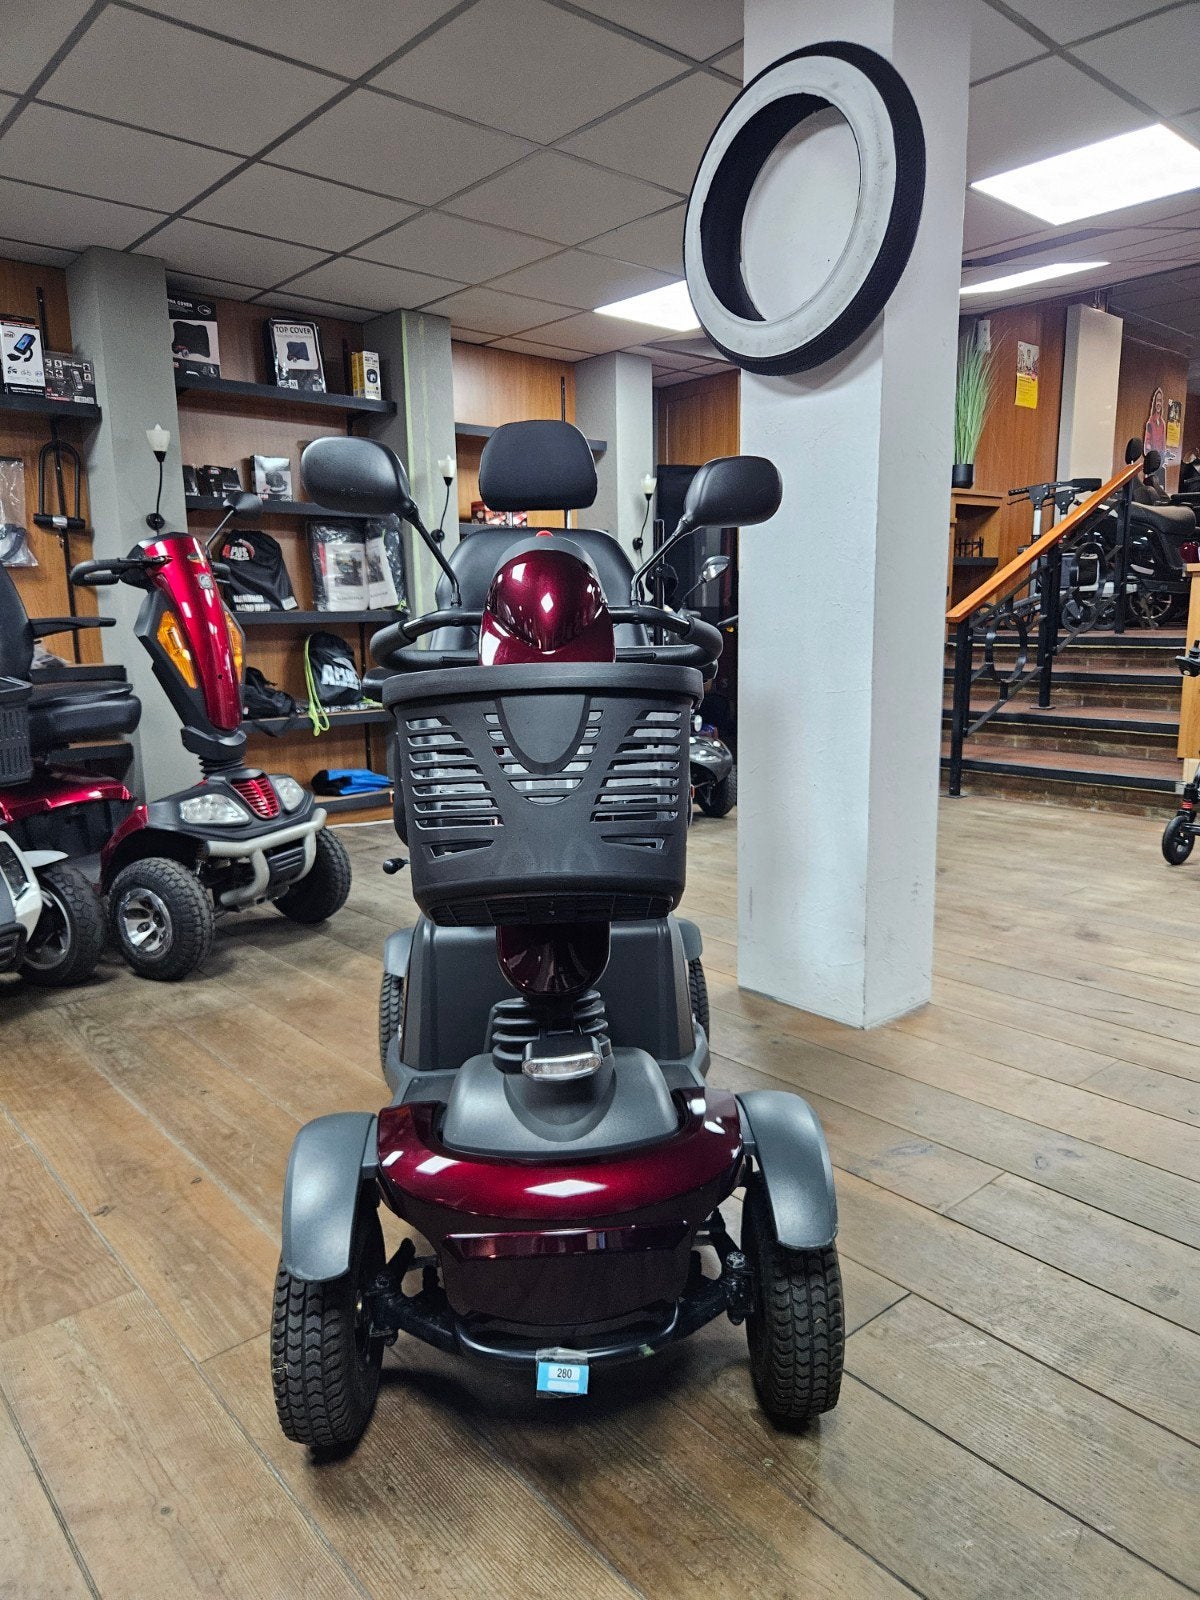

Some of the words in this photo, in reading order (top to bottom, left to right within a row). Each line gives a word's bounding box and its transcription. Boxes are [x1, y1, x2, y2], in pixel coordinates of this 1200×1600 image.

[275, 325, 289, 333] TOP
[289, 326, 312, 335] COVER
[556, 1368, 573, 1379] 280
